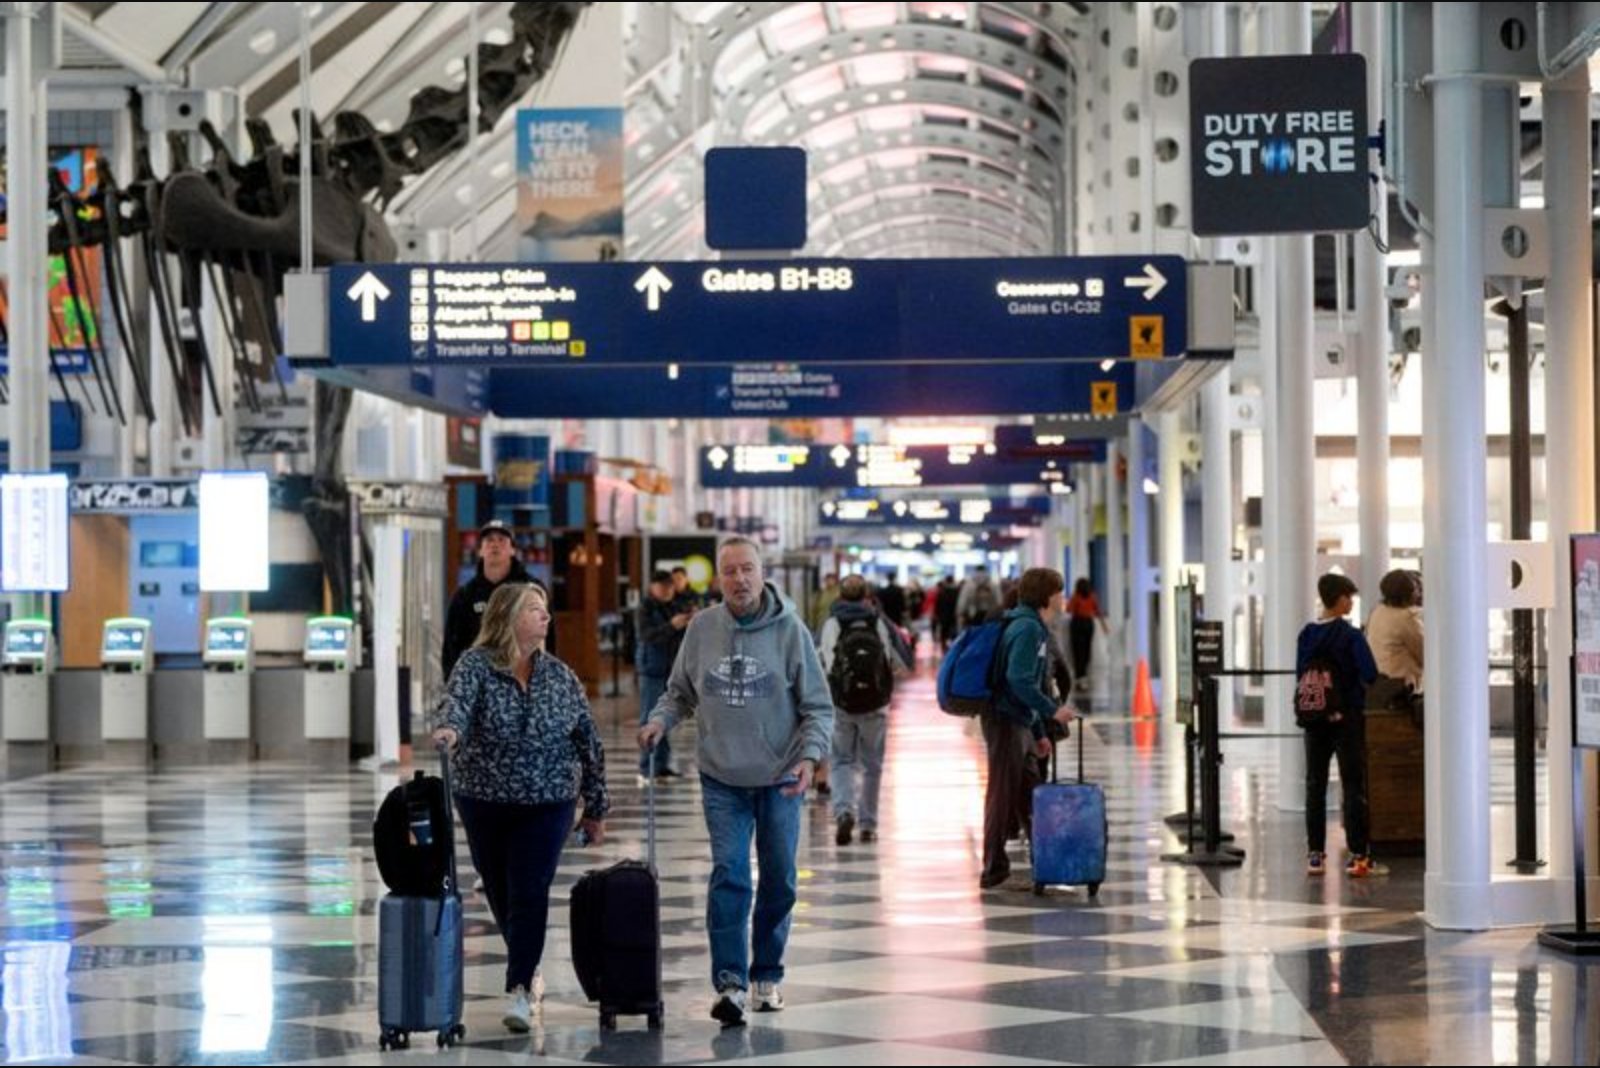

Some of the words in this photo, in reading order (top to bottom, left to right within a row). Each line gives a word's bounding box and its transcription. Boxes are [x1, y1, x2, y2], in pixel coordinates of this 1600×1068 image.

[529, 121, 589, 140] HECK
[1204, 112, 1278, 136] DUTY
[1285, 111, 1354, 134] FREE
[528, 142, 588, 160] YEAH
[702, 267, 775, 292] Gates
[780, 267, 853, 291] B1-B8
[1008, 302, 1048, 315] Gates
[1051, 301, 1102, 314] C1-C32
[435, 343, 490, 356] Transfer
[493, 344, 507, 356] to
[510, 343, 567, 356] Terminal
